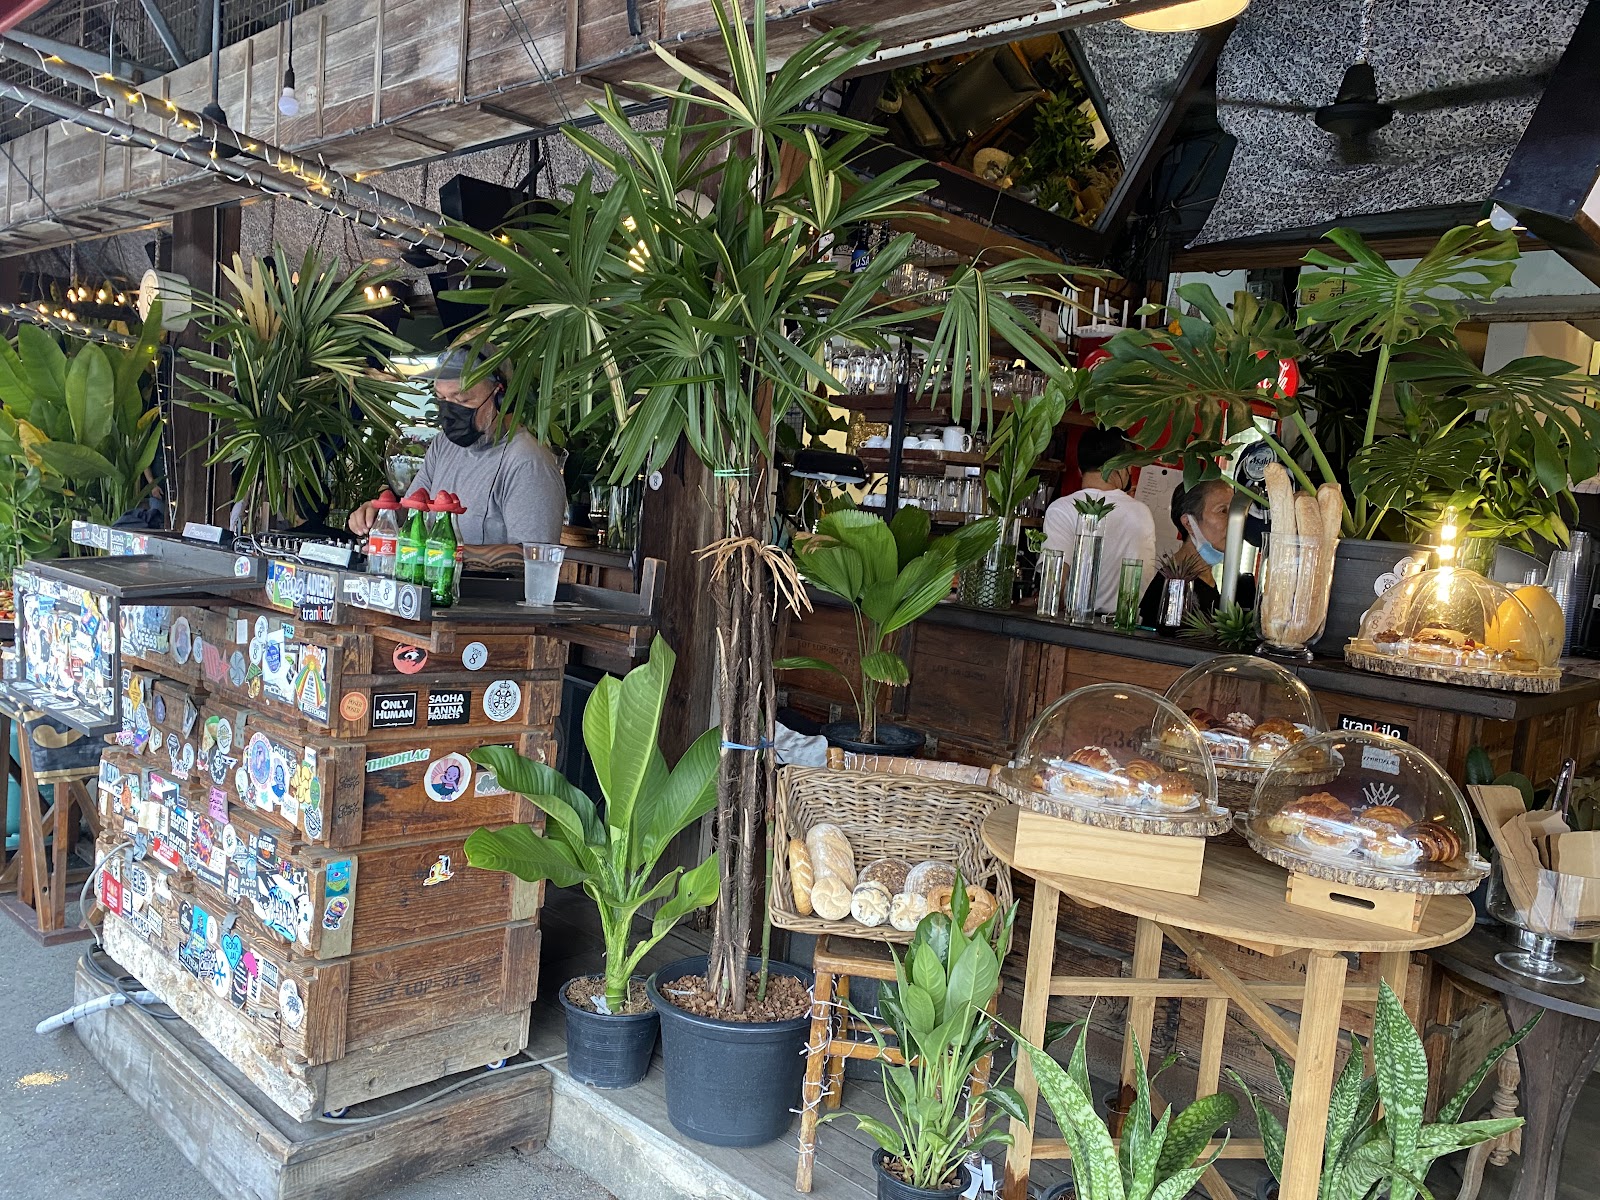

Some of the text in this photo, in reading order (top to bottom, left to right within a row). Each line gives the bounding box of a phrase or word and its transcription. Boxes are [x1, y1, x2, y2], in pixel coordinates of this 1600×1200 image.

[1309, 293, 1316, 301] 8
[400, 550, 417, 561] Sprite
[427, 553, 443, 565] Sprite
[381, 700, 409, 710] ONLY
[428, 705, 464, 715] LANNA
[375, 709, 413, 720] HUMAN
[428, 713, 461, 721] PROJECTS
[1342, 717, 1401, 739] trankilo
[367, 750, 430, 771] THIRDFLAG
